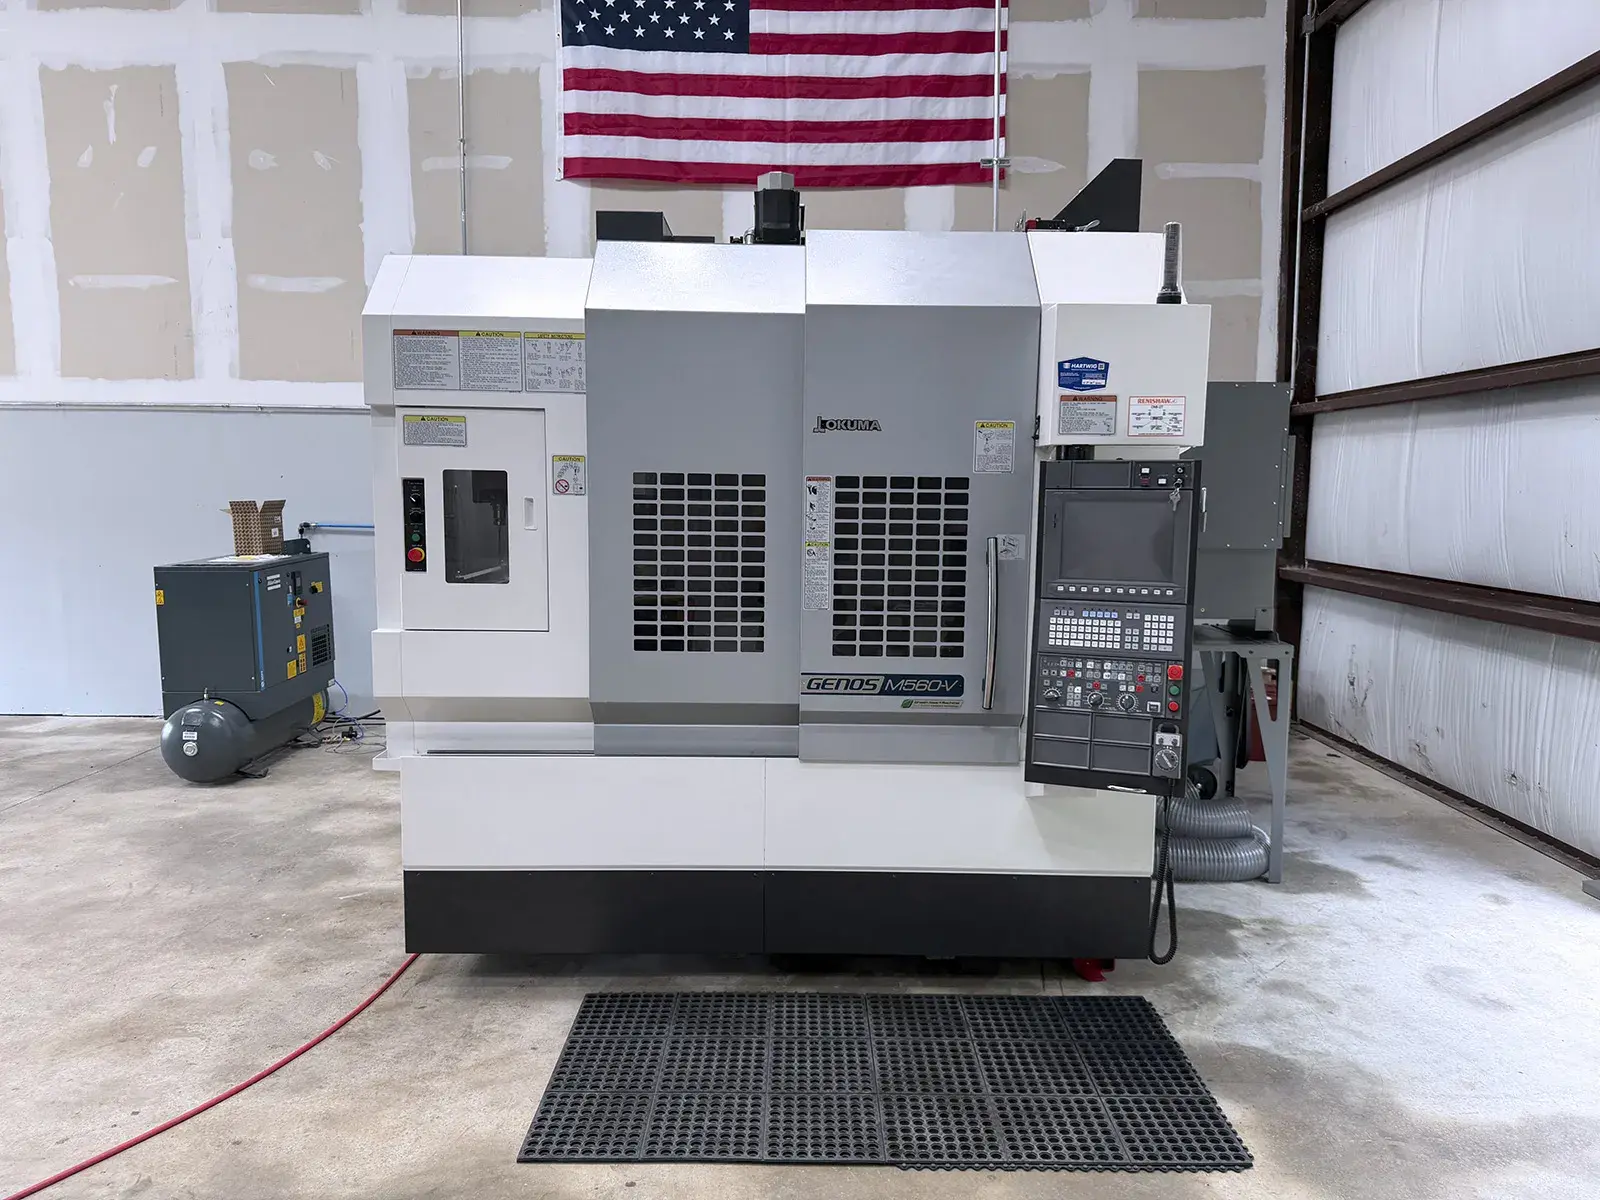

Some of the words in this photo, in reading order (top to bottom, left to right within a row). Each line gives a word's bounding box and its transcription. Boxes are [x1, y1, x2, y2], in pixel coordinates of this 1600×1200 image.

[825, 418, 882, 431] OKUMA
[807, 678, 880, 691] GENOS
[884, 679, 959, 692] M560-V
